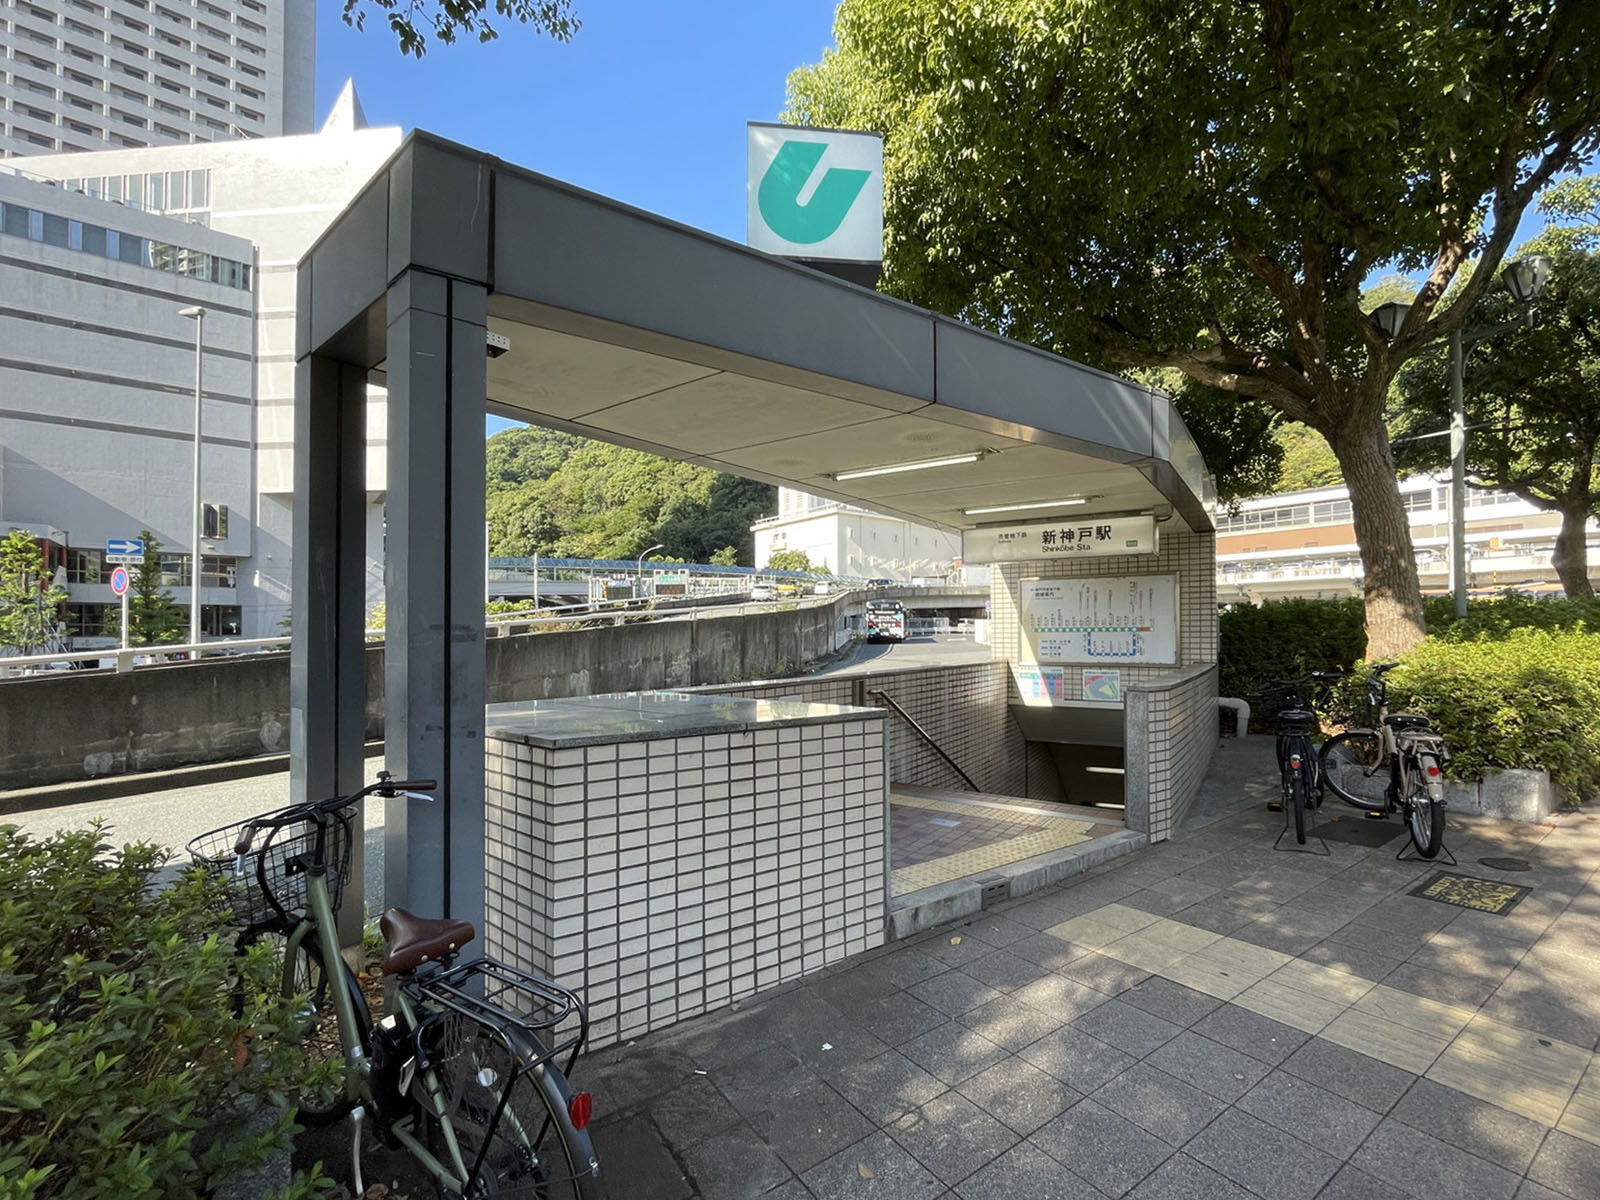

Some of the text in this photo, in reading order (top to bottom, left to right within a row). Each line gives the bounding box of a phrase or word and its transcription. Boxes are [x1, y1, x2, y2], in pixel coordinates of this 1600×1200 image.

[1041, 525, 1112, 545] 新神戸駅
[1076, 543, 1093, 551] Sta.
